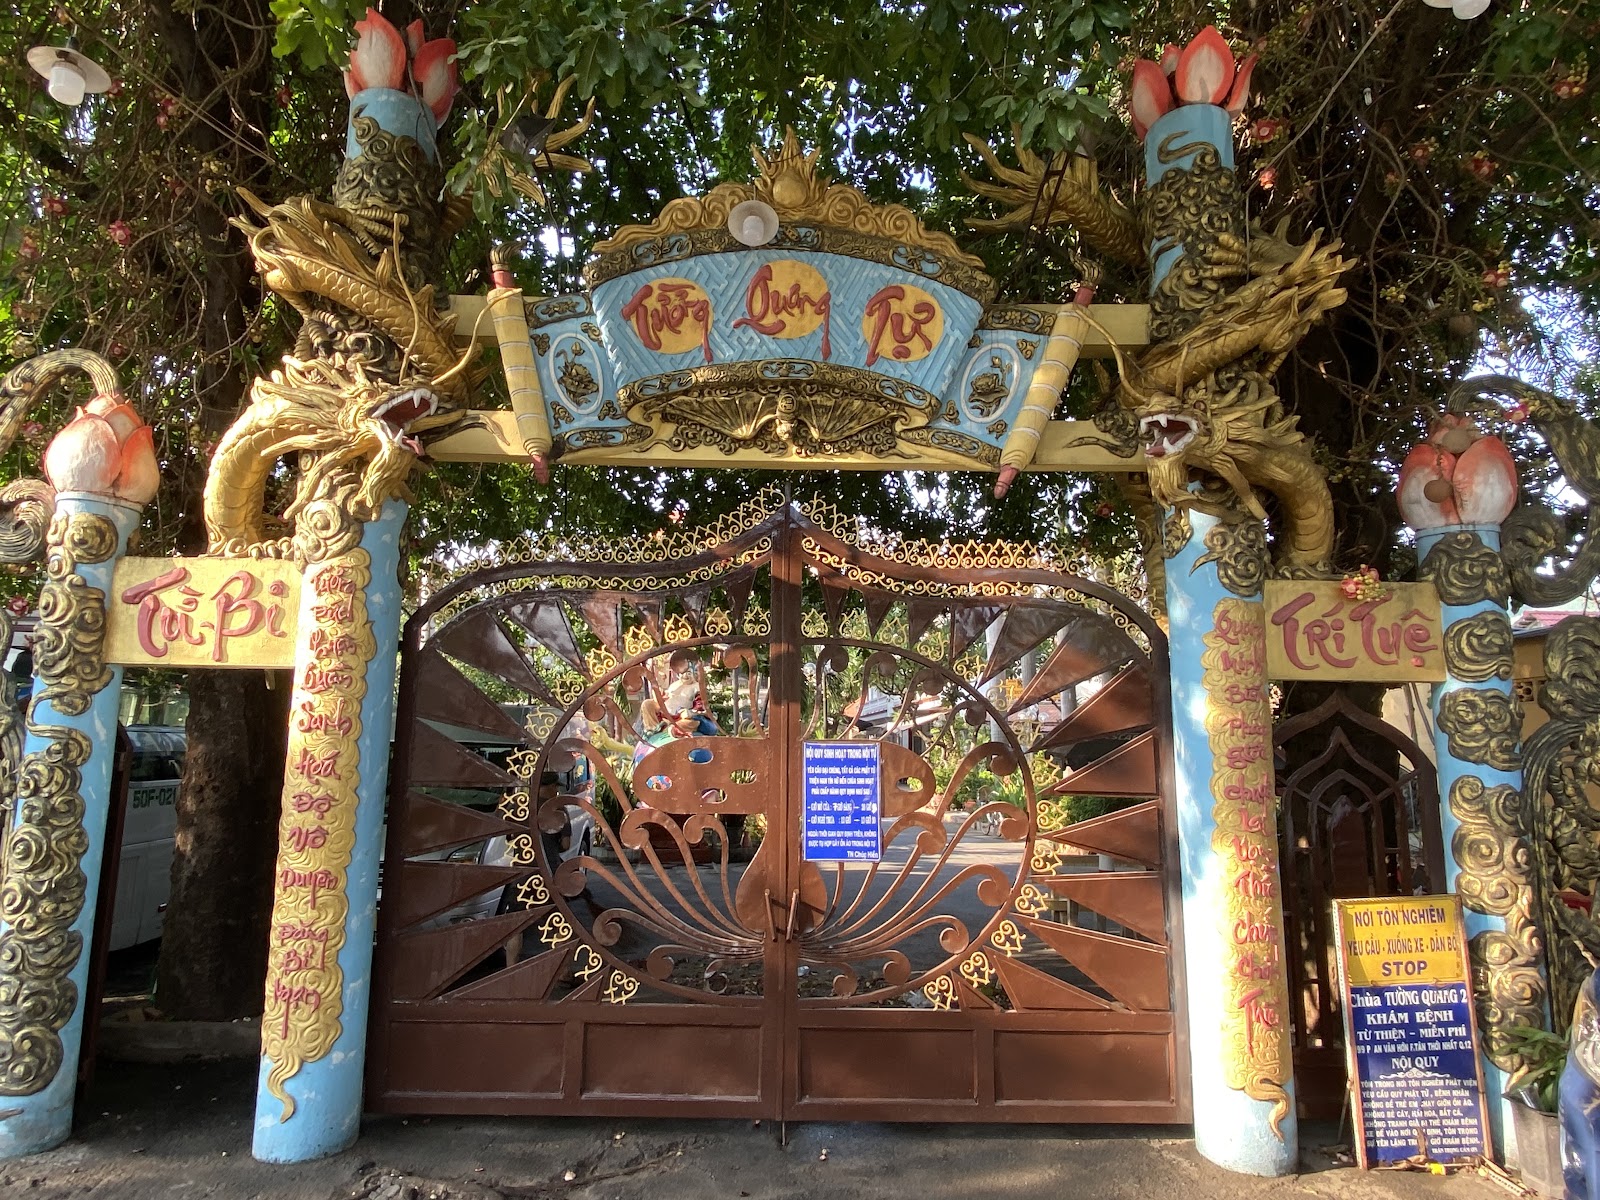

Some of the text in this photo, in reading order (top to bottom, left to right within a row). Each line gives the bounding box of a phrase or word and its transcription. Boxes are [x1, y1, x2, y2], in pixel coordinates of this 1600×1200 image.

[732, 264, 832, 360] Quang
[864, 285, 936, 367] Tự
[1349, 591, 1438, 668] Tuệ
[292, 792, 339, 820] Độ
[287, 826, 330, 852] Vô
[280, 867, 338, 909] Duyên
[1376, 907, 1400, 926] TÔN
[1402, 905, 1446, 925] NGHIÊM
[1386, 931, 1413, 955] XUỐNG
[1413, 938, 1425, 953] XE
[1381, 960, 1428, 977] STOP
[1351, 992, 1382, 1008] Chùa
[1421, 989, 1459, 1007] QUANG
[1460, 989, 1468, 1003] 2
[1366, 1009, 1454, 1025] KHÁM BỆNH
[1357, 1028, 1372, 1040] TỪ
[1374, 1028, 1406, 1041] THIỆN
[1447, 1024, 1467, 1037] PHÍ
[1391, 1056, 1439, 1070] NỘI QUY
